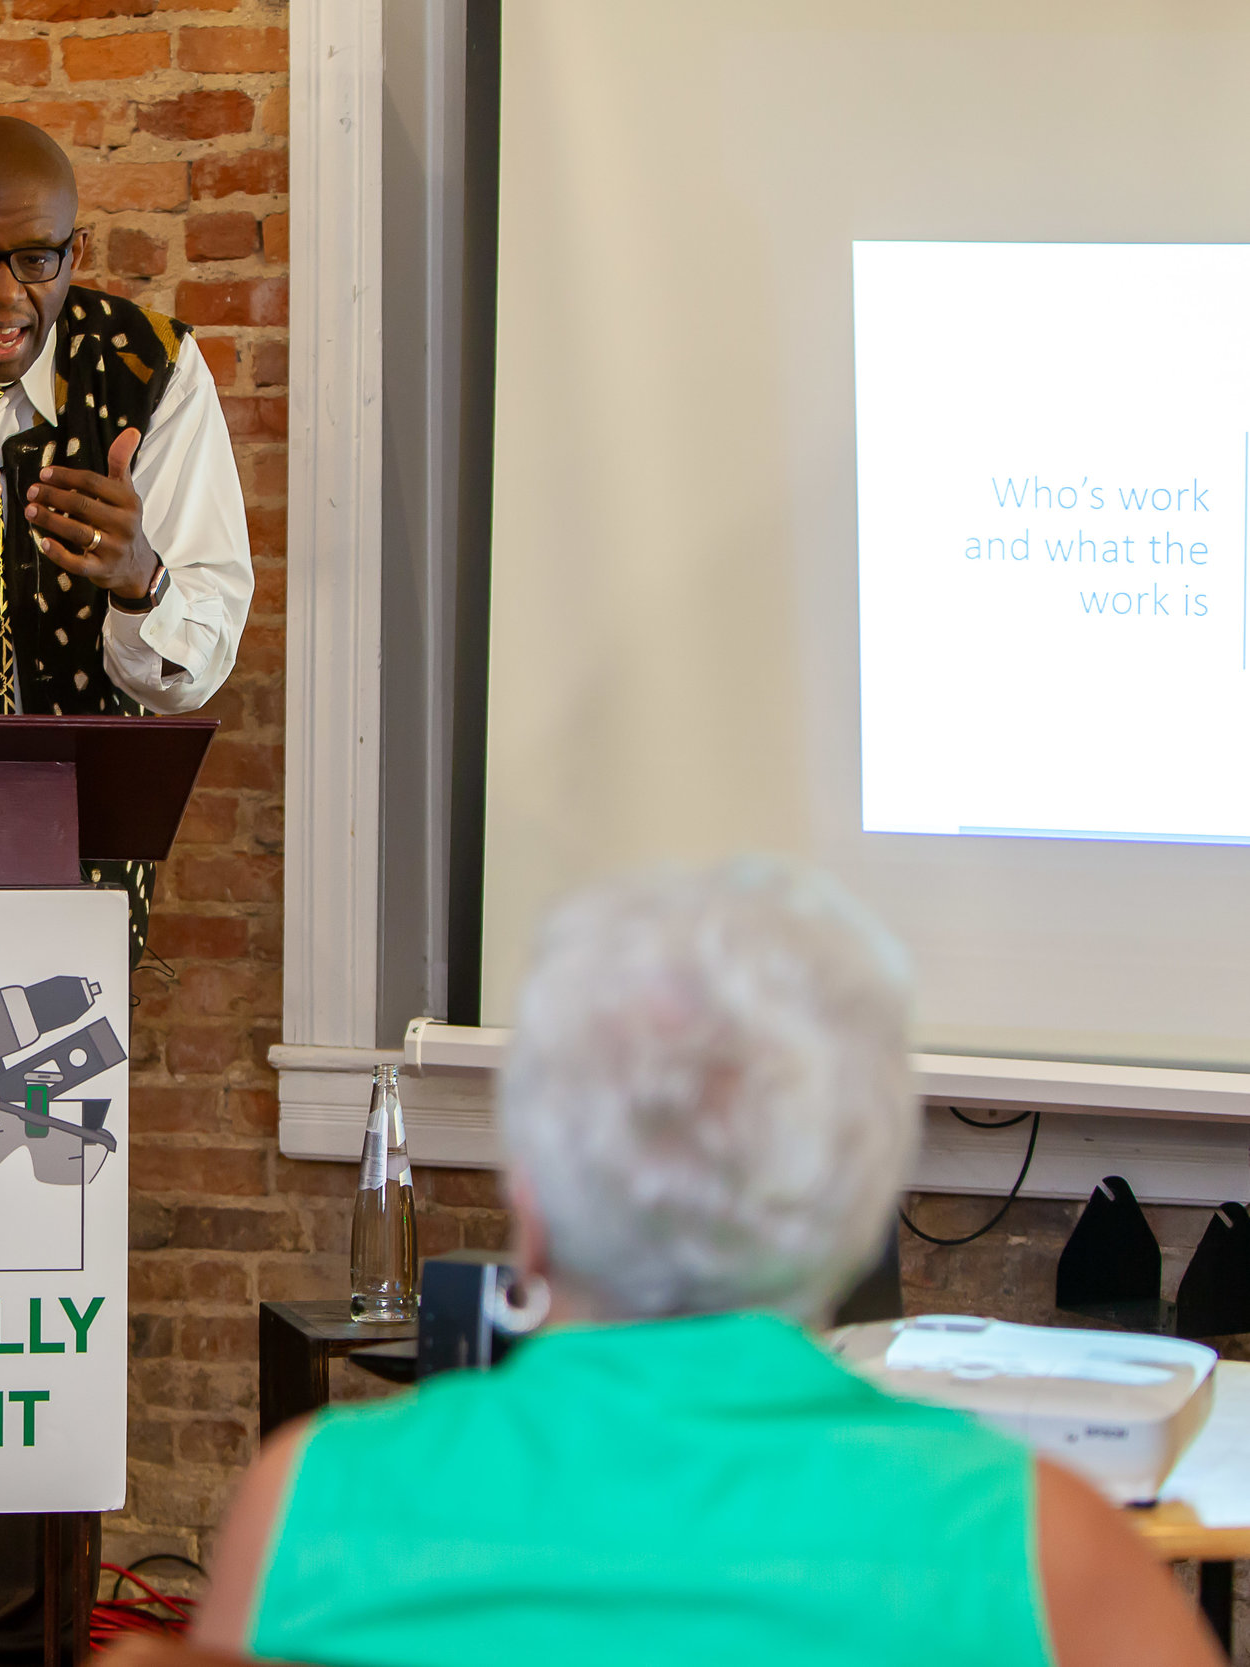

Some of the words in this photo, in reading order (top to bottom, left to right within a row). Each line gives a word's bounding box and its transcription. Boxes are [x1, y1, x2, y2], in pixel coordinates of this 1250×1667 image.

[991, 476, 1105, 510] Who's
[1119, 478, 1210, 512] work
[965, 529, 1030, 561] and
[1045, 530, 1135, 564] what
[1149, 531, 1209, 565] the
[1079, 582, 1170, 616] work
[1184, 584, 1209, 617] is
